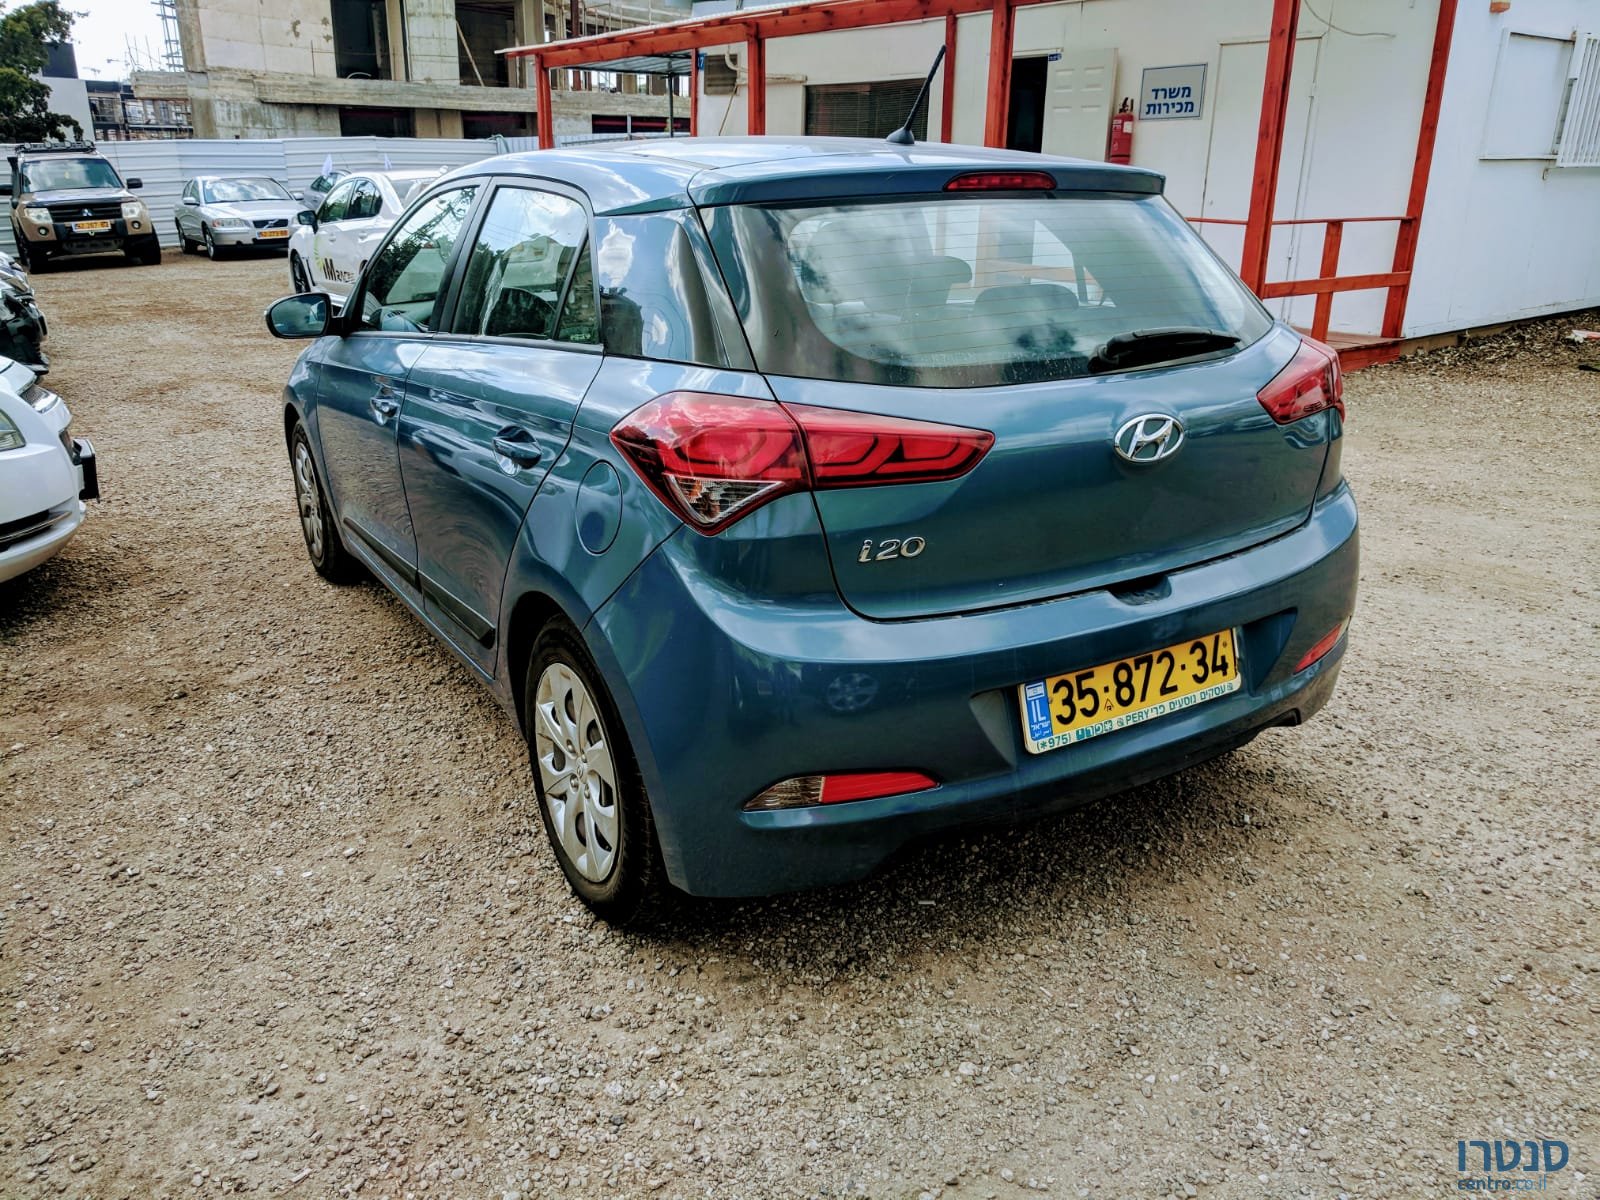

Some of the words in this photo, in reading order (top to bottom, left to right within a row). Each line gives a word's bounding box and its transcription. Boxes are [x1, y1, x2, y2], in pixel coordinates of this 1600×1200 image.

[1152, 86, 1192, 100] משרד
[1145, 101, 1195, 115] מכירות
[858, 536, 926, 562] i20
[1030, 699, 1047, 723] IL
[1125, 708, 1150, 726] PERY
